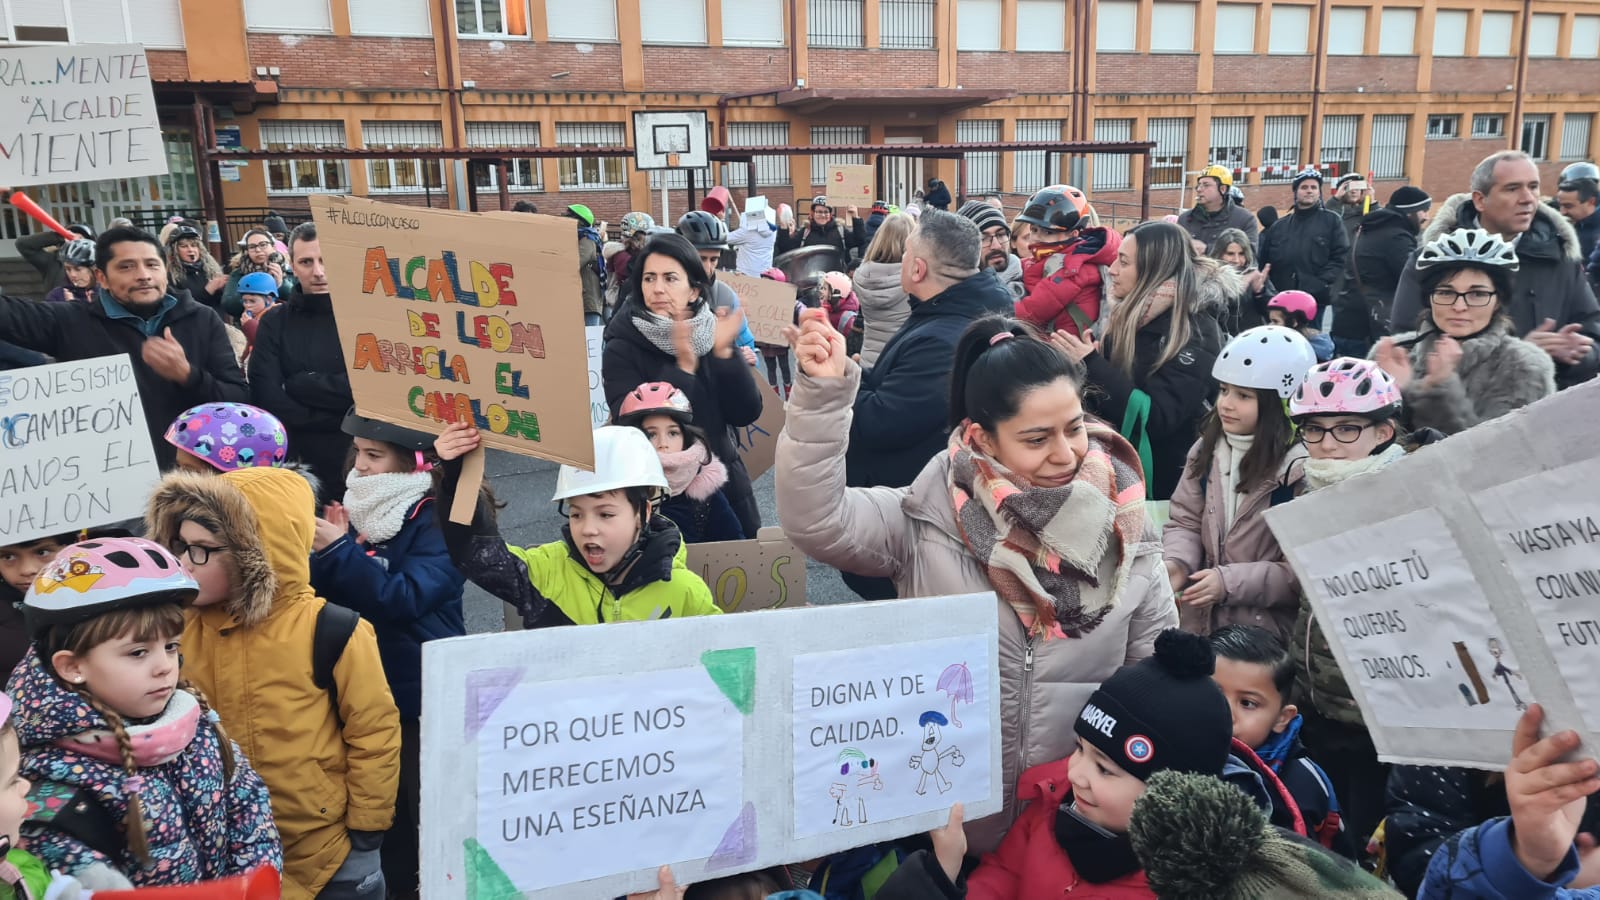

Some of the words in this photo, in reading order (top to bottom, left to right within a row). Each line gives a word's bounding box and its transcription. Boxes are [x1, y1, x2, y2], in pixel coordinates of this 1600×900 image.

[362, 246, 518, 308] ALCALDE
[407, 309, 440, 338] DE
[456, 310, 546, 359] LEÓN
[353, 332, 470, 384] ARREGLA
[495, 362, 530, 400] EL
[408, 385, 541, 442] CANALÓN
[102, 440, 150, 472] EL
[1508, 522, 1576, 554] VASTA
[1568, 516, 1600, 543] YA
[1322, 575, 1347, 599] NO
[1344, 570, 1369, 594] LO
[1367, 561, 1403, 590] QUE
[1401, 549, 1430, 582] TÚ
[1535, 572, 1580, 600] CON
[1343, 609, 1407, 639] QUIERAS
[1361, 654, 1431, 679] DARNOS.
[811, 680, 877, 708] DIGNA
[882, 678, 894, 698] Y
[900, 674, 925, 696] DE
[503, 720, 560, 750] POR
[569, 712, 624, 743] QUE
[633, 705, 686, 733] NOS
[810, 716, 904, 747] CALIDAD.
[1080, 703, 1118, 738] MARVEL
[502, 750, 676, 796] MERECEMOS
[502, 811, 564, 842] UNA
[573, 788, 706, 831] ESEÑANZA
